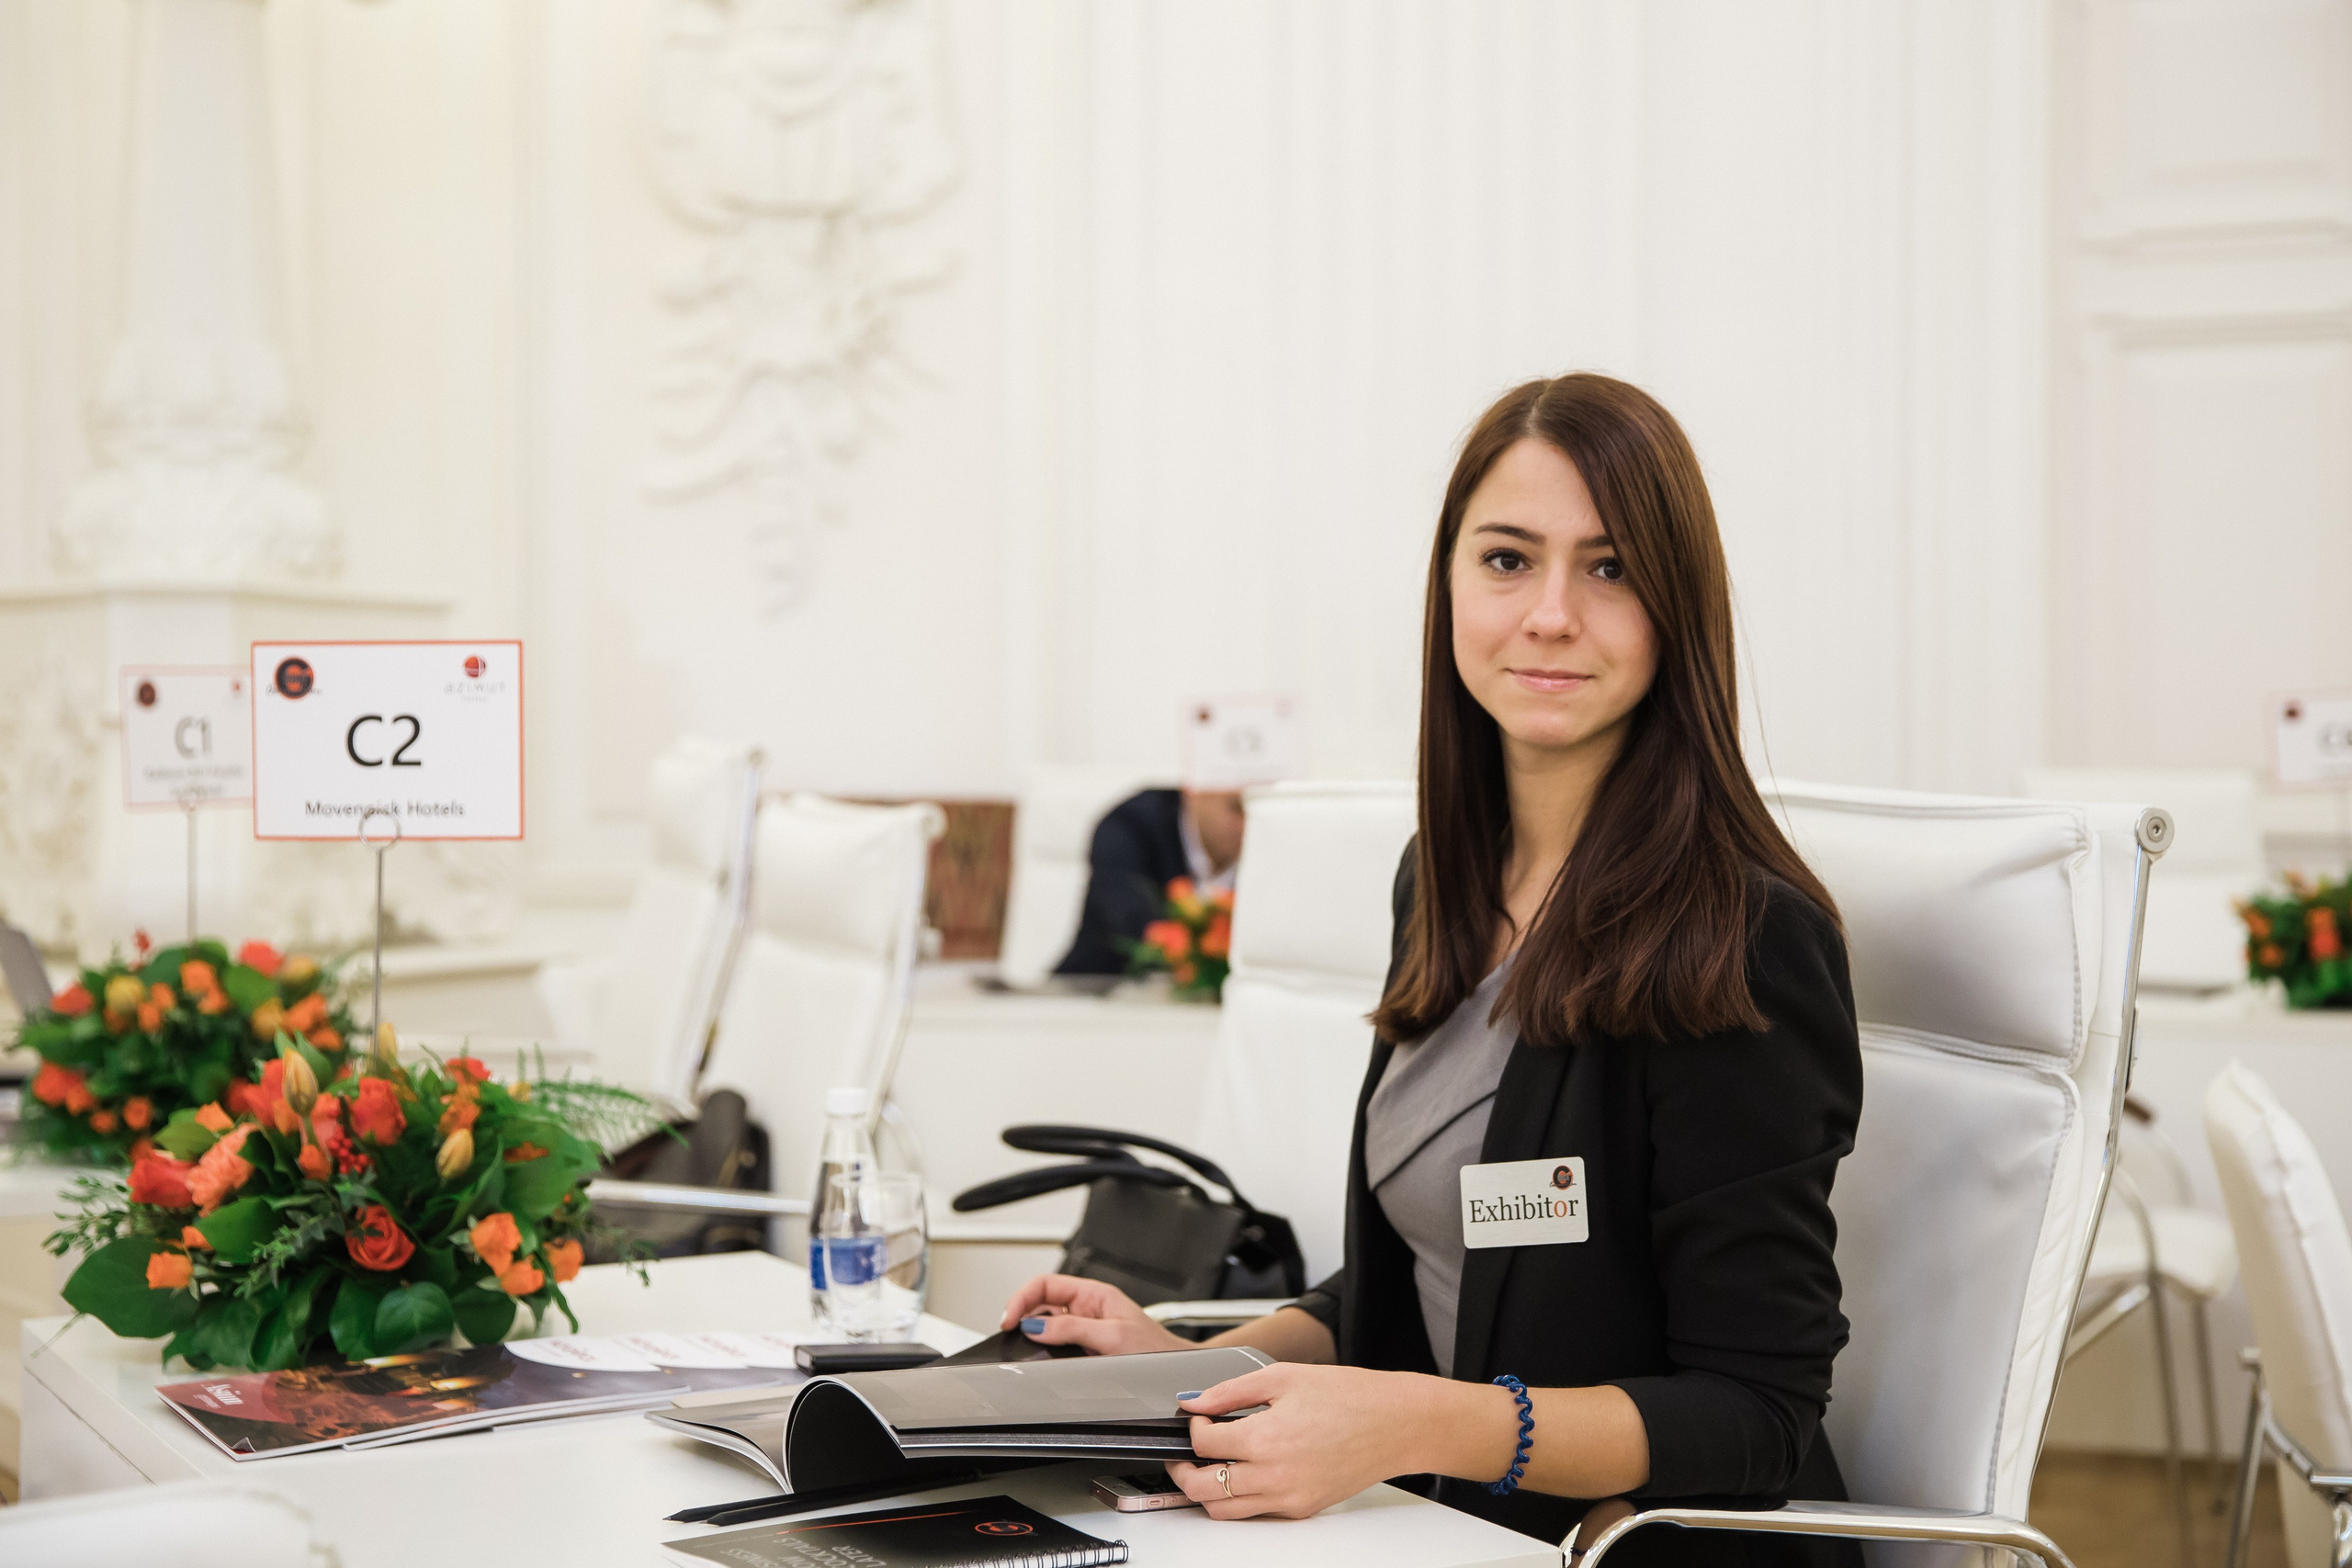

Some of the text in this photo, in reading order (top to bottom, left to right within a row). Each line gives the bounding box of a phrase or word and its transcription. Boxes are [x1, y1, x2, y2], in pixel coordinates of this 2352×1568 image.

[175, 716, 211, 760] C1
[346, 715, 422, 767] C2
[407, 800, 465, 817] Hotels
[1468, 1194, 1578, 1223] Exhibitor
[831, 1545, 887, 1567] LATER
